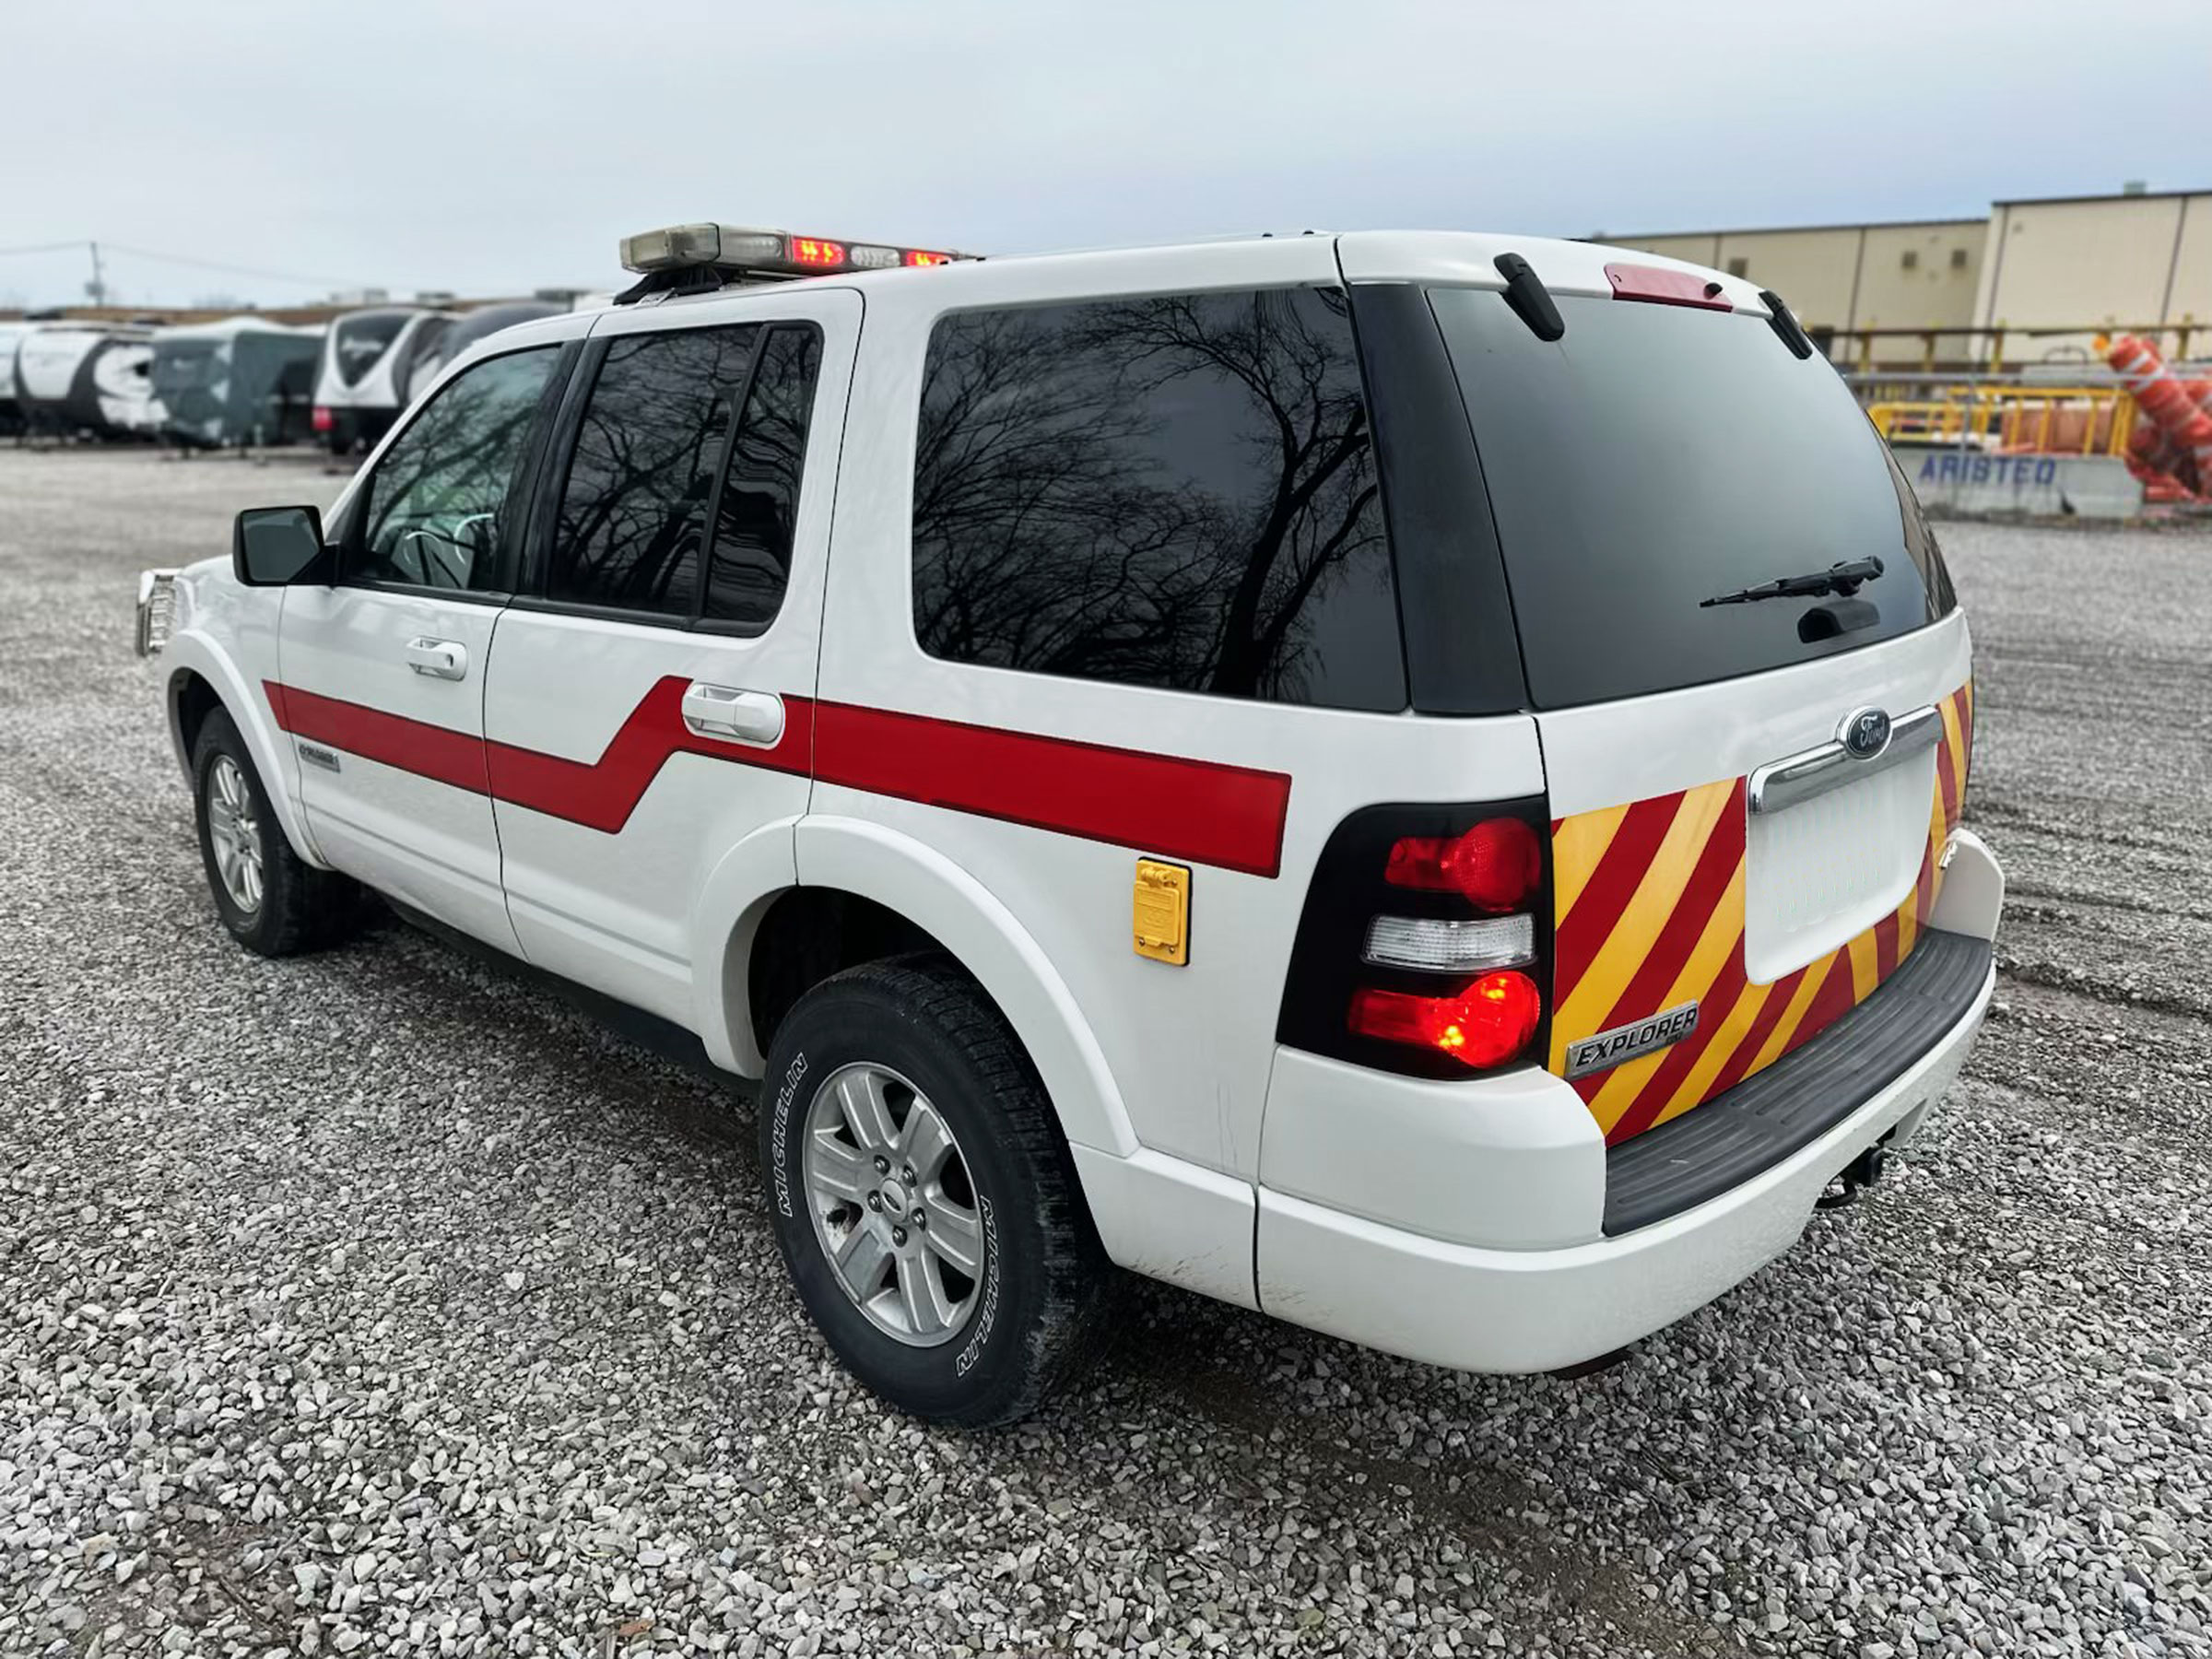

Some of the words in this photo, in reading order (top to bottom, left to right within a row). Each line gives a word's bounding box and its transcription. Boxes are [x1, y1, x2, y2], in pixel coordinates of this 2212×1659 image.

[1919, 455, 2056, 485] ARISTEO
[1860, 714, 1886, 747] Ford
[1575, 1007, 1697, 1067] EXPLORER
[772, 1052, 808, 1218] MICHELIN
[956, 1194, 1000, 1377] MICHELIN
